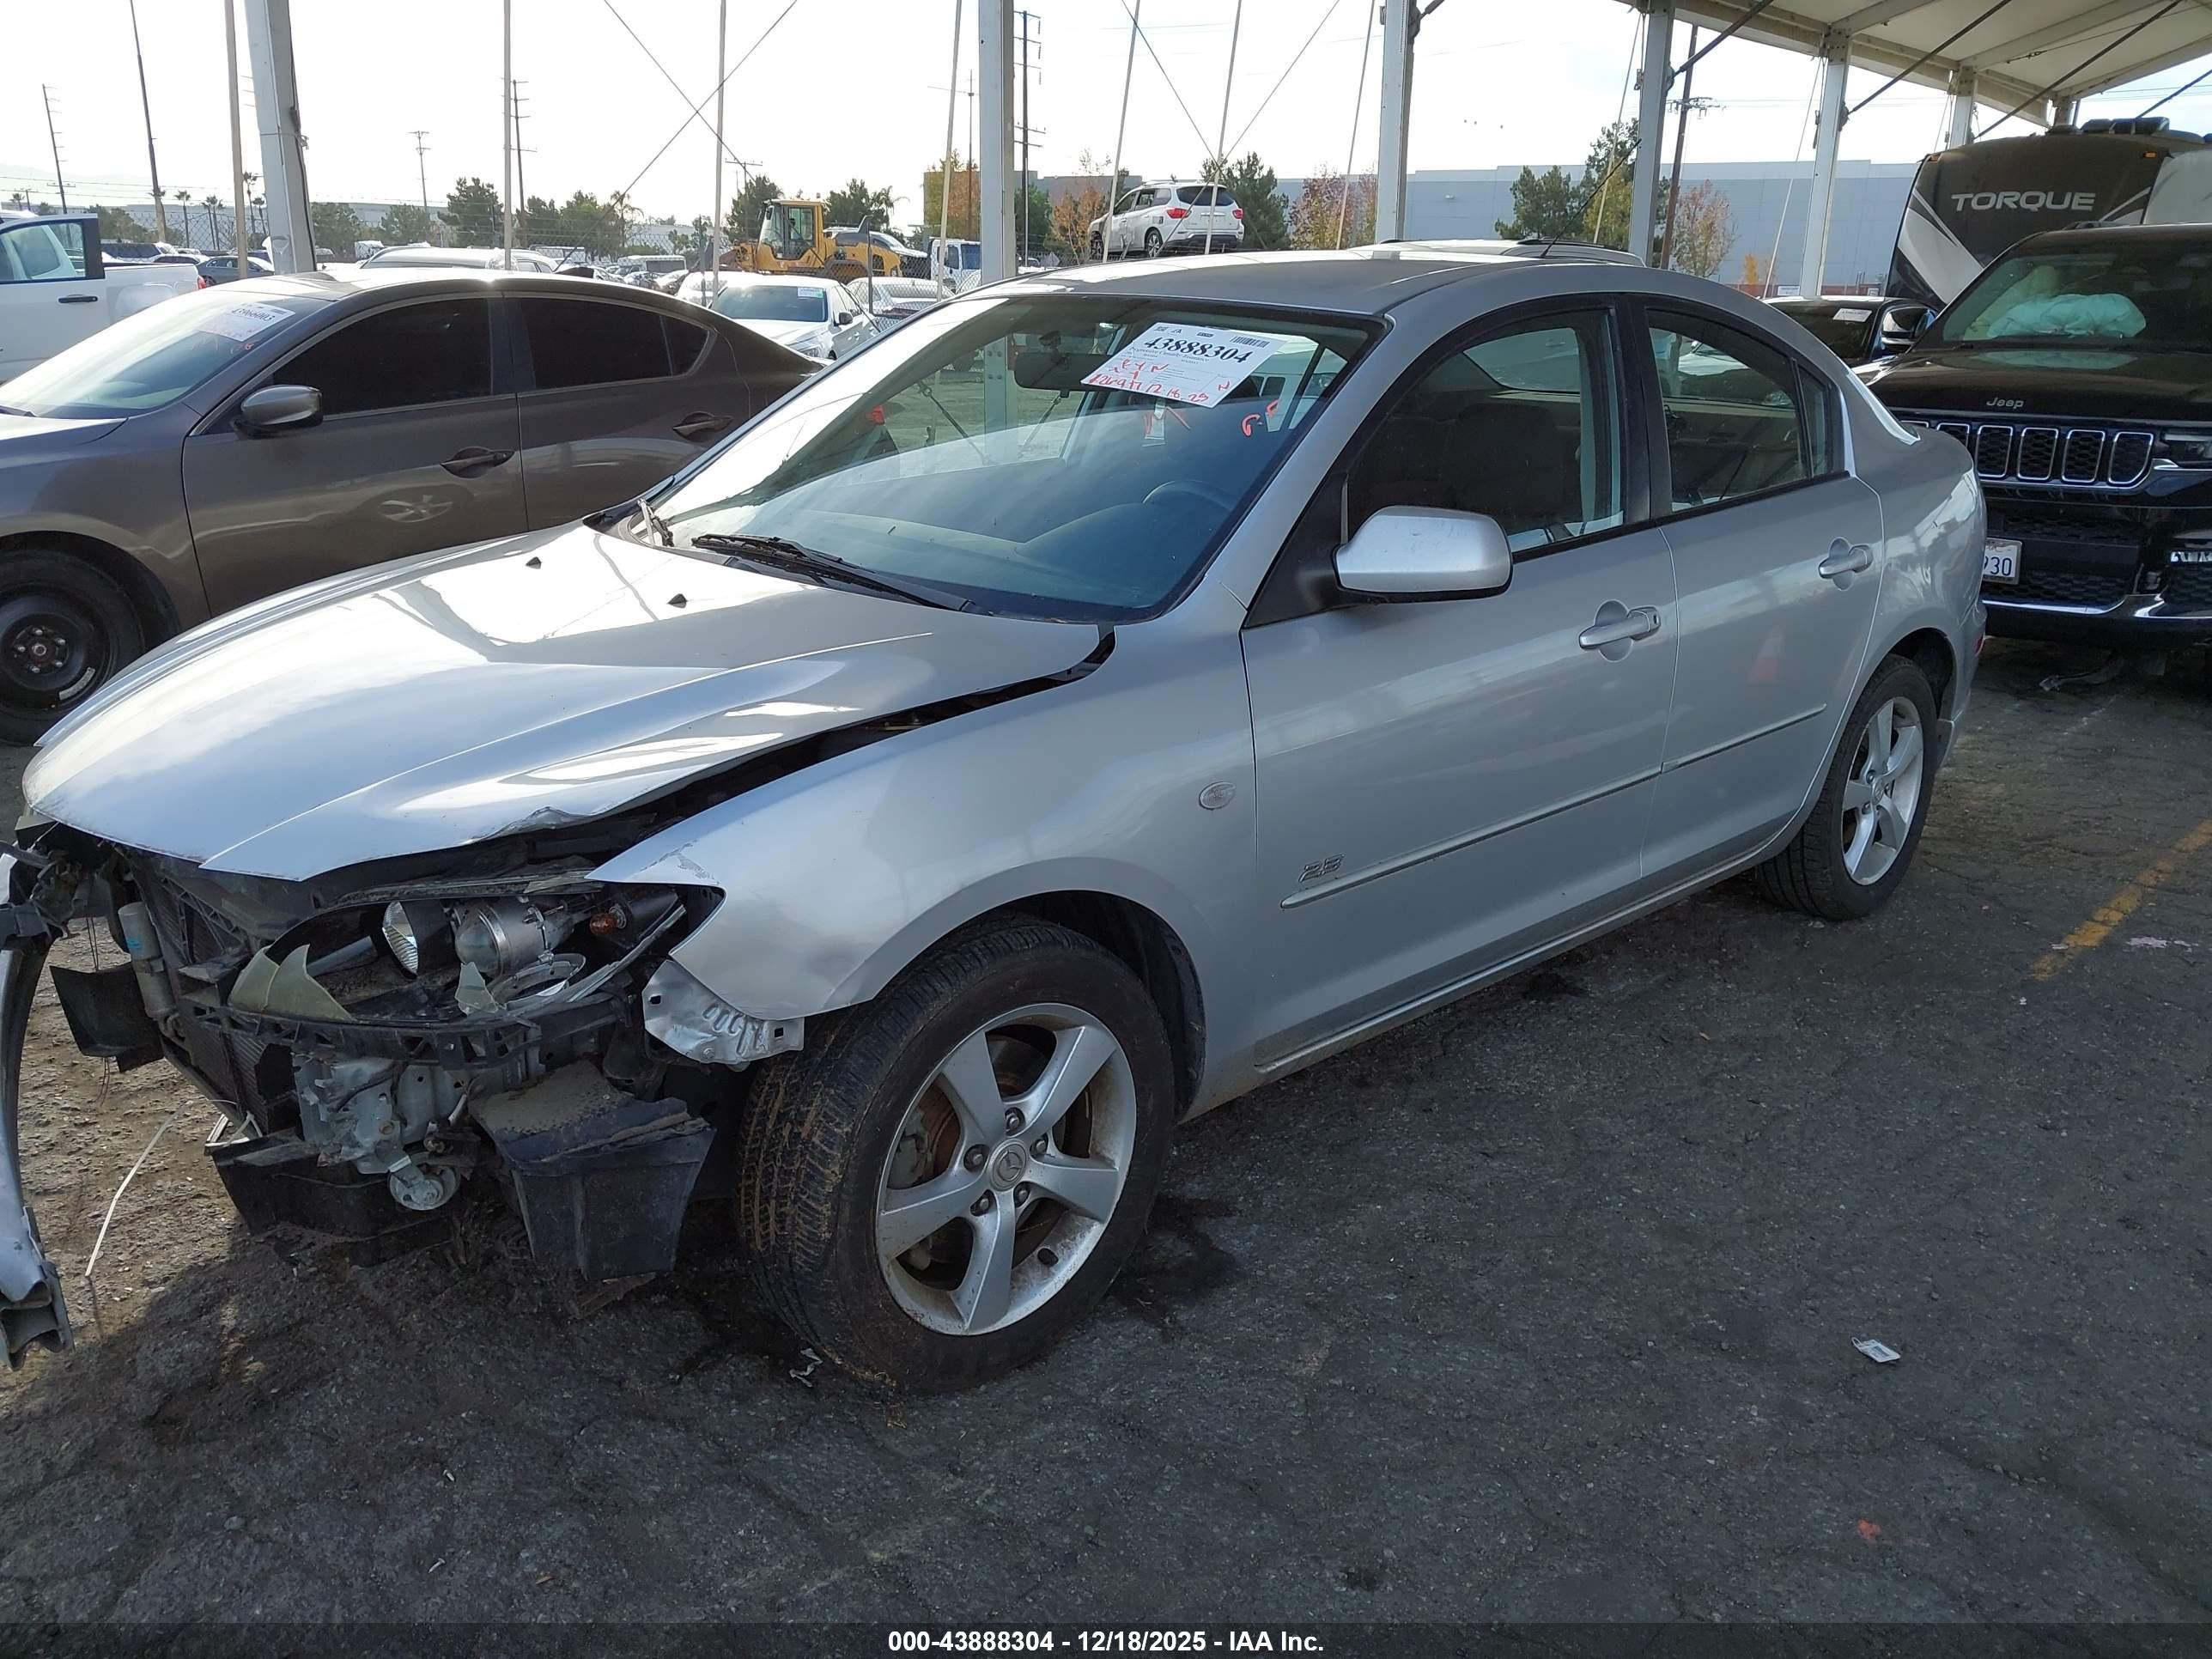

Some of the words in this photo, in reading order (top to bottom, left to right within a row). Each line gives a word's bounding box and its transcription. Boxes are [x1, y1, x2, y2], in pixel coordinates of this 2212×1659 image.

[1951, 191, 2095, 212] TORQUE
[1144, 337, 1254, 363] 43888304
[1986, 397, 2024, 410] Jeep
